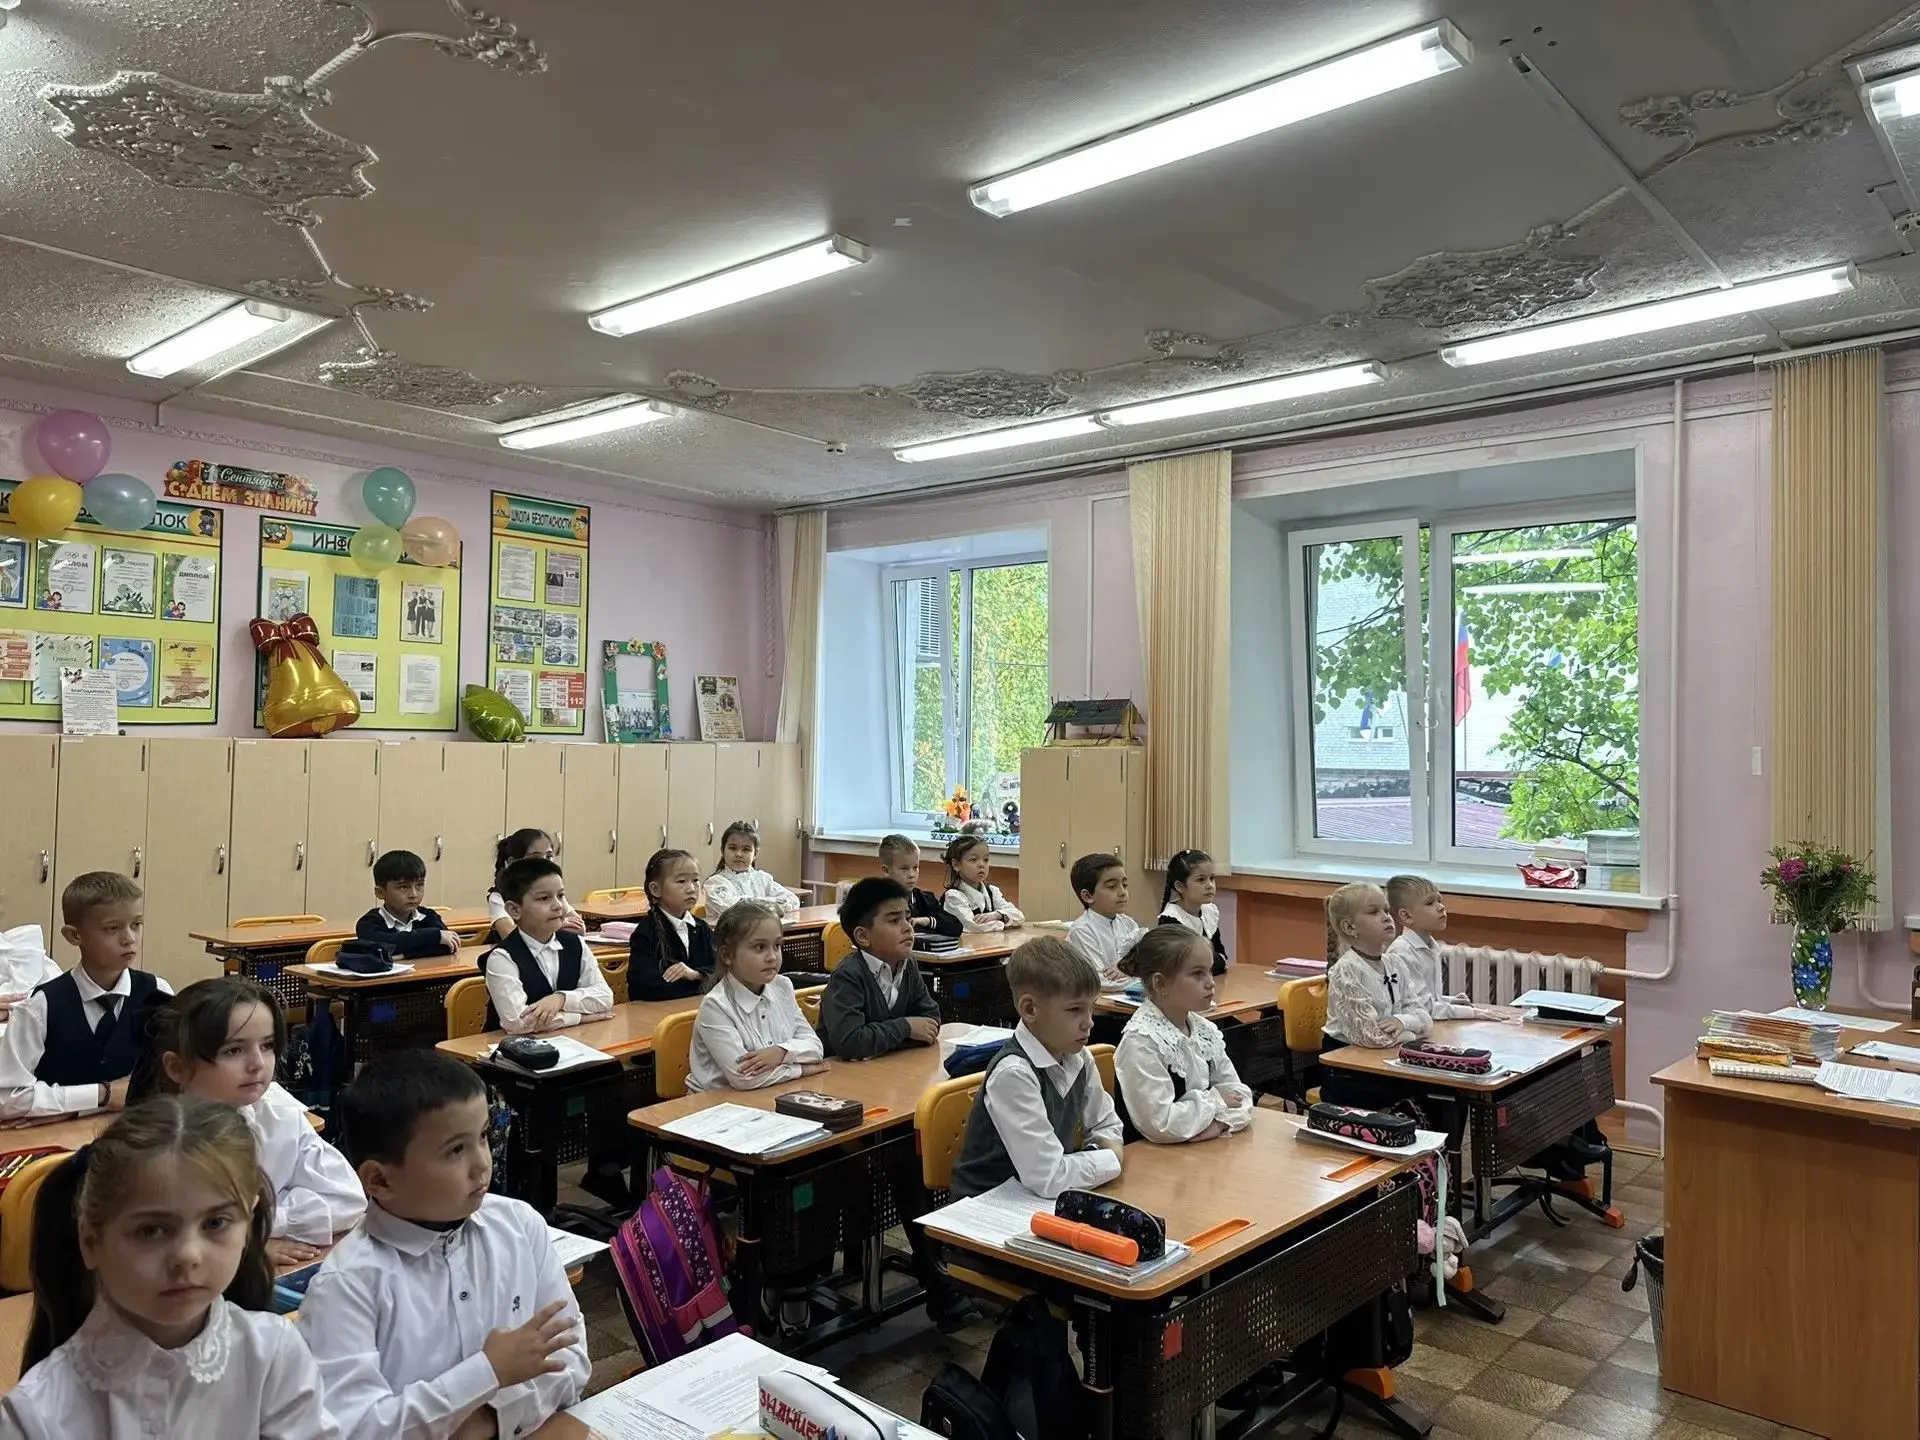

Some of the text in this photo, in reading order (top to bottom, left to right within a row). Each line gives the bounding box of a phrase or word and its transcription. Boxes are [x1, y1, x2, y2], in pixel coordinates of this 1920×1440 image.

[204, 465, 285, 489] 1 Сентября!
[168, 481, 180, 496] С
[150, 512, 186, 529] ЛОК
[511, 510, 530, 523] ШКОЛА
[312, 532, 351, 551] ИНФ
[54, 559, 89, 568] ДЛОМ
[179, 571, 210, 579] ДИПЛОМ
[569, 697, 584, 705] 112
